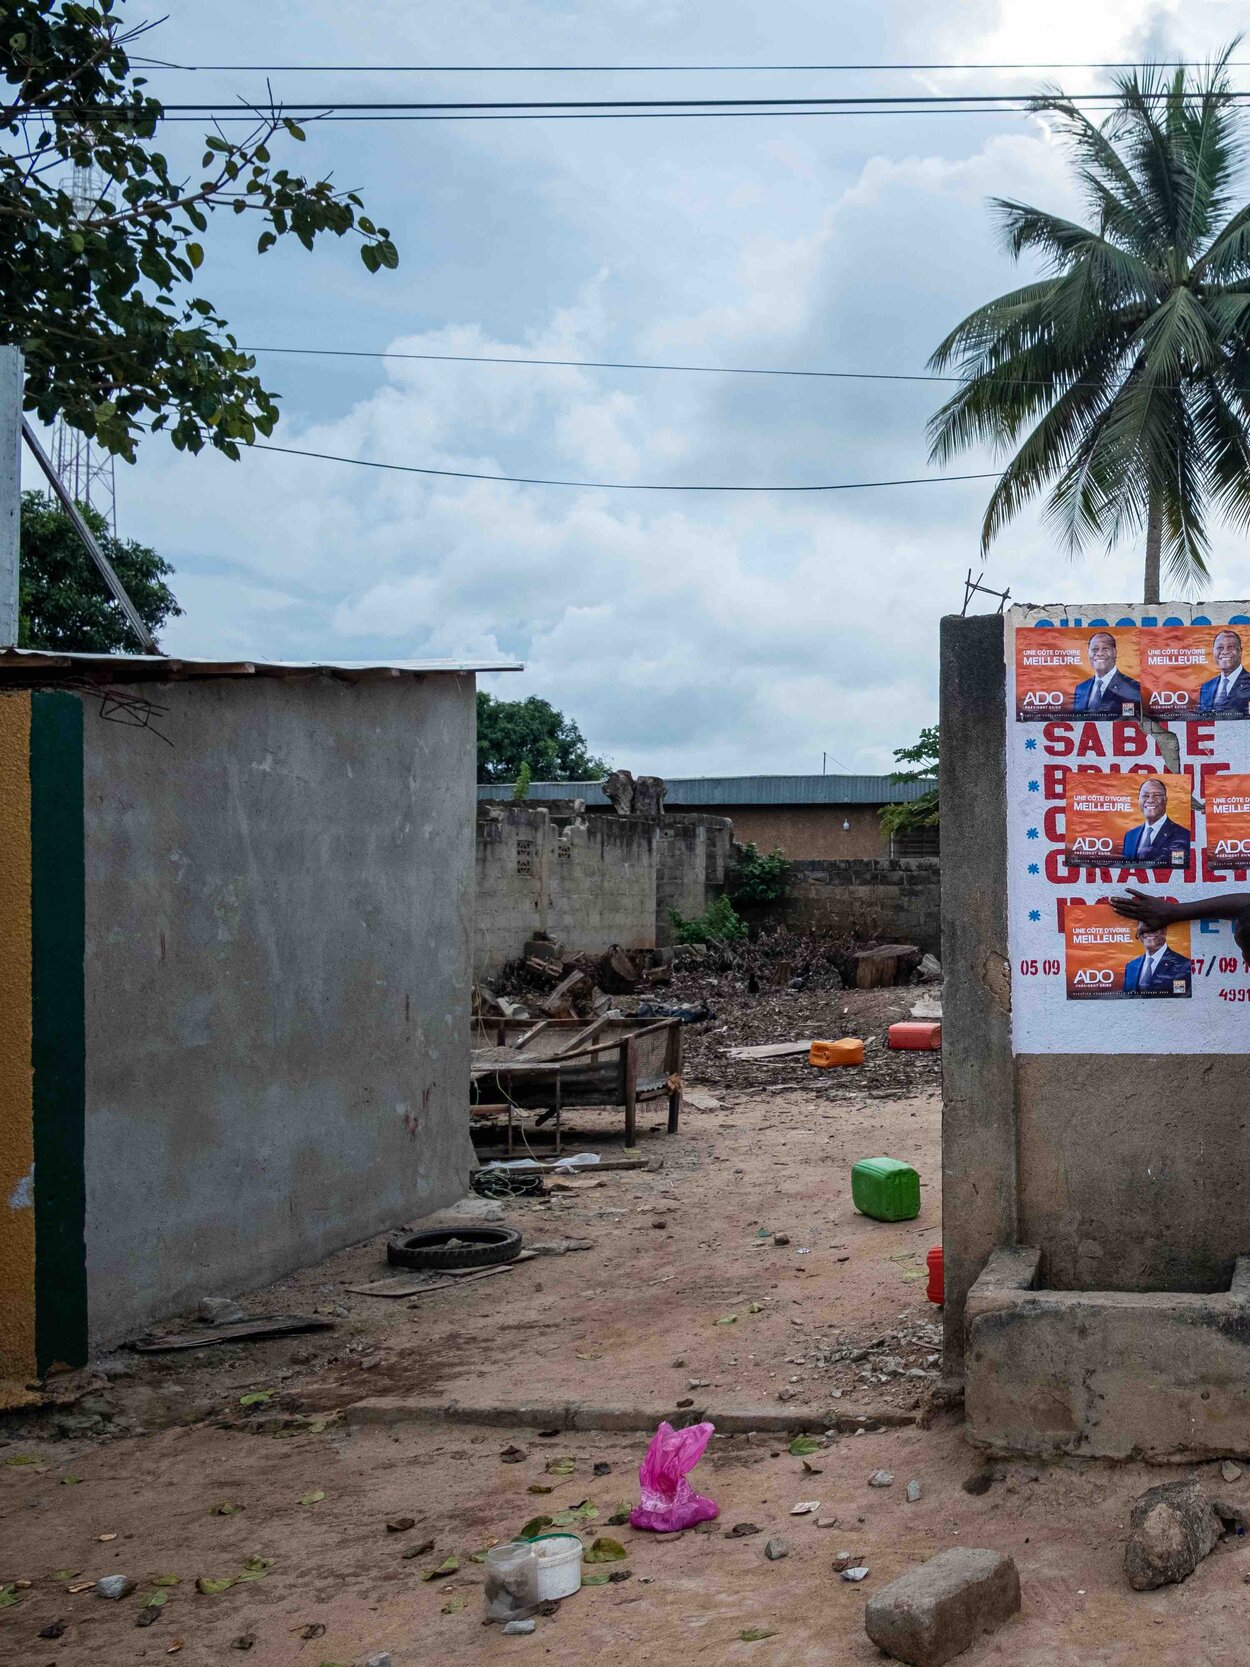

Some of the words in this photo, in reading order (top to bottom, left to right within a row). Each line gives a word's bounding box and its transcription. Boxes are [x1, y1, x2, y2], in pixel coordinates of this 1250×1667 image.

[1024, 657, 1082, 665] MEILLEURE.
[1148, 656, 1208, 664] MEILLEURE.
[1023, 692, 1063, 705] ADO
[1149, 691, 1188, 705] ADO
[1074, 803, 1133, 811] MEILLEURE.
[1072, 838, 1112, 851] ADO
[1073, 935, 1133, 943] MEILLEURE.
[1021, 960, 1038, 975] 05
[1043, 960, 1060, 975] 09
[1219, 957, 1238, 973] 09
[1073, 970, 1114, 983] ADO
